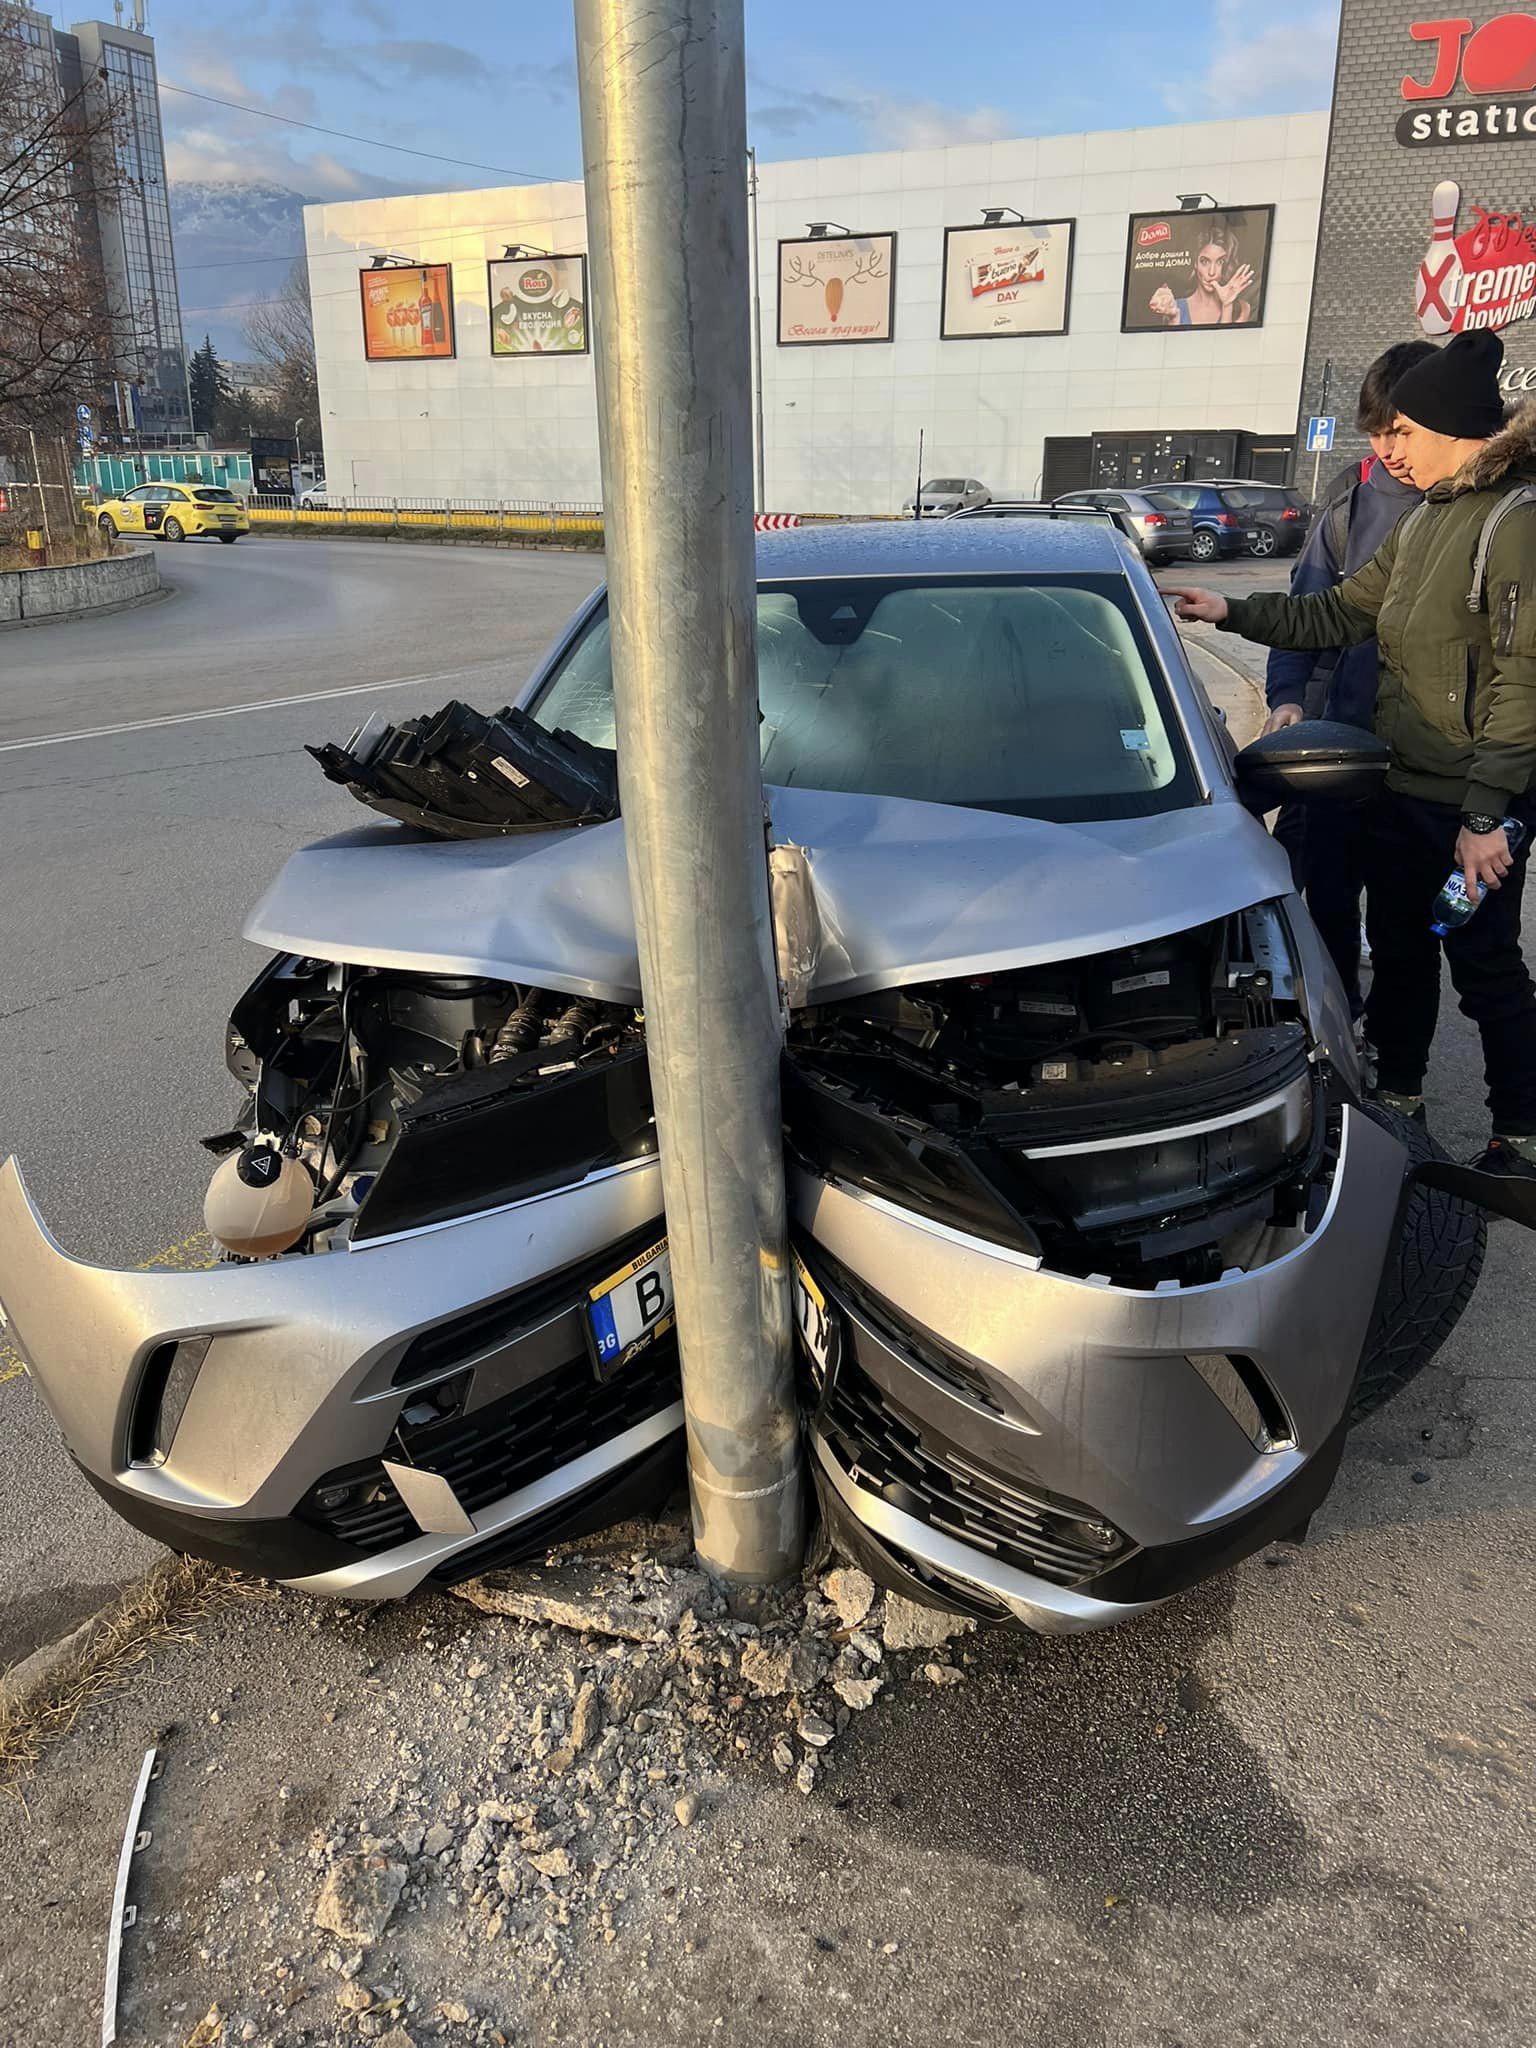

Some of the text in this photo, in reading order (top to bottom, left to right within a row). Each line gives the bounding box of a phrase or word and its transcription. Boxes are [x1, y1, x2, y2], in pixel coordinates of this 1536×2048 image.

[997, 290, 1019, 303] DAY
[1417, 254, 1536, 321] Xtreme
[1462, 293, 1536, 331] bowling
[1316, 419, 1328, 434] P
[632, 1238, 669, 1271] BULGARIA
[635, 1270, 665, 1327] B
